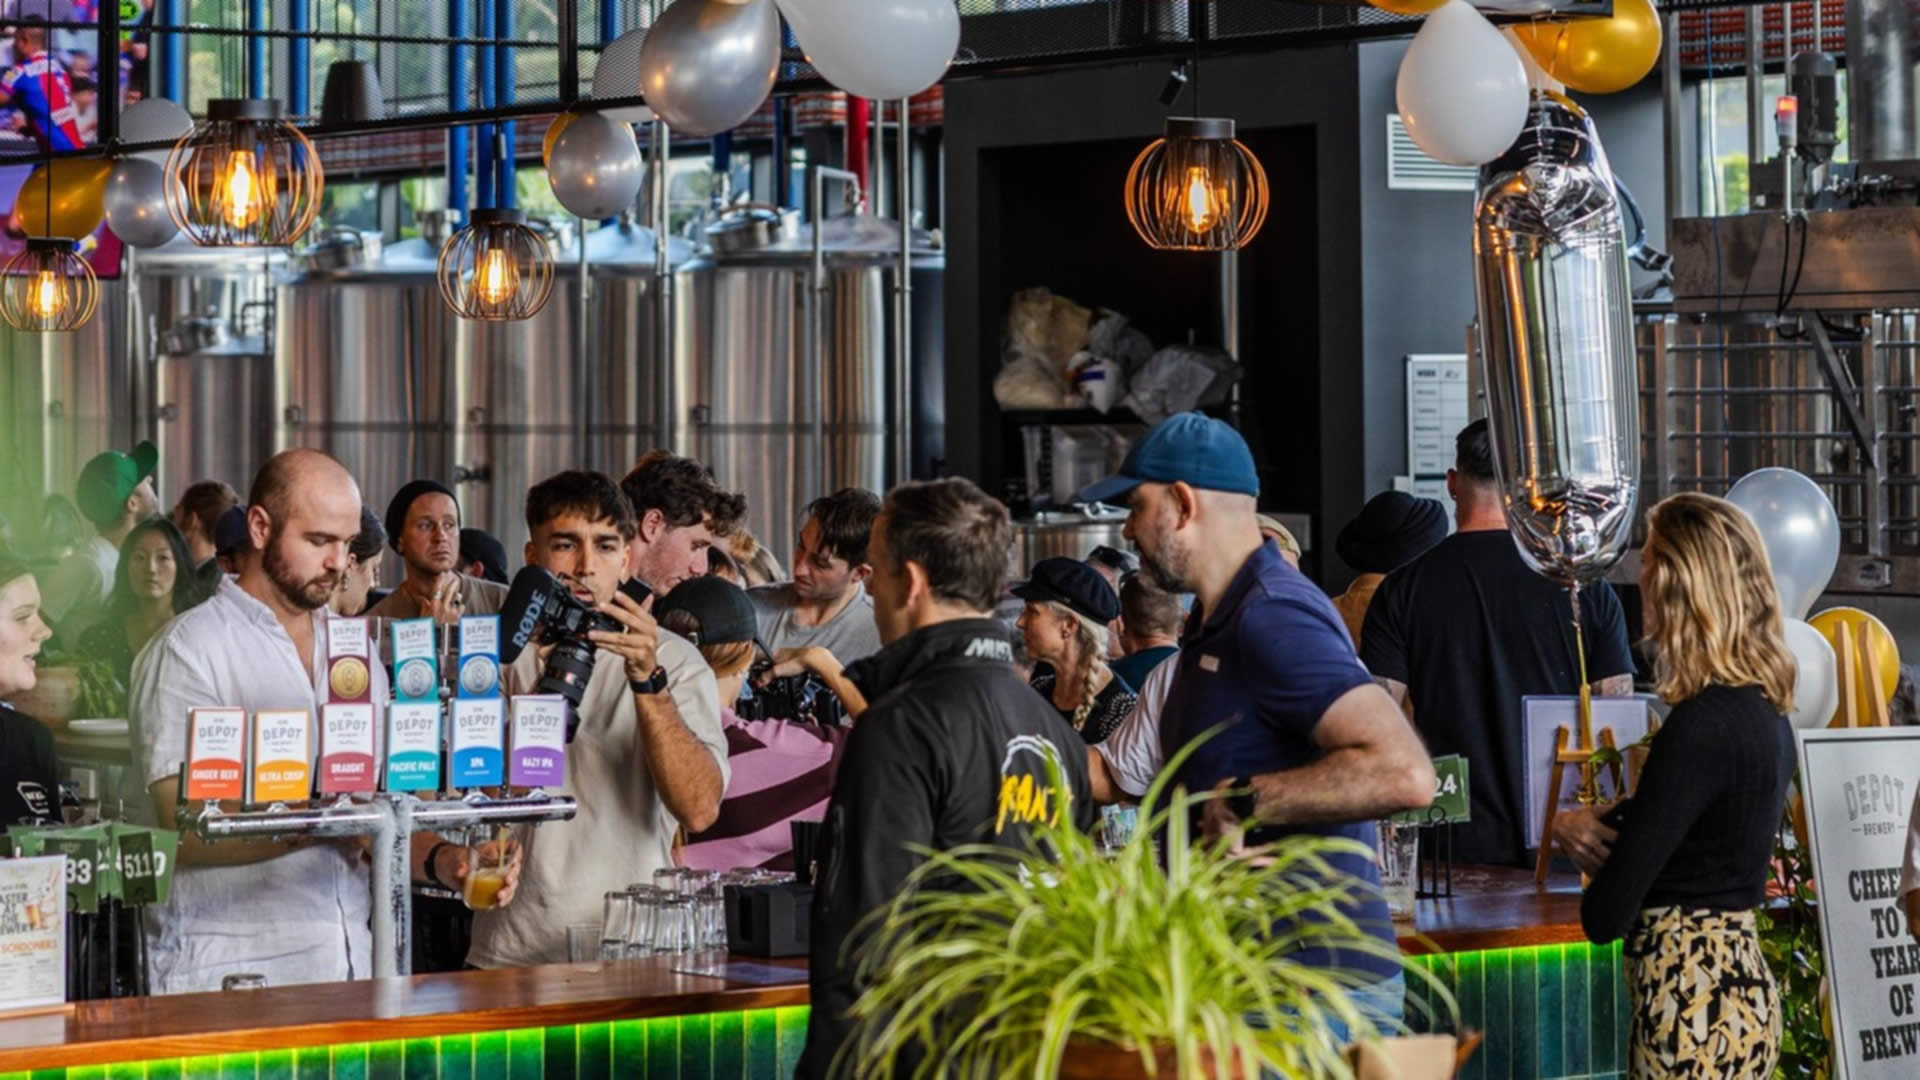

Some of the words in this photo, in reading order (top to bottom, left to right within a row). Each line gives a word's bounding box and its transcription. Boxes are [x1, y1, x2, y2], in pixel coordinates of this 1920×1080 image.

[328, 718, 368, 733] DEPOT
[395, 717, 434, 732] DEPOT
[458, 714, 497, 728] DEPOT
[520, 714, 560, 728] DEPOT
[198, 724, 240, 739] DEPOT
[262, 726, 304, 741] DEPOT
[191, 769, 218, 780] GINGER
[219, 768, 240, 780] BEER
[330, 762, 365, 774] DRAUGHT
[1843, 773, 1905, 822] DEPOT
[1863, 821, 1896, 837] BREWERY
[1870, 906, 1900, 940] TO
[1889, 983, 1915, 1018] OF
